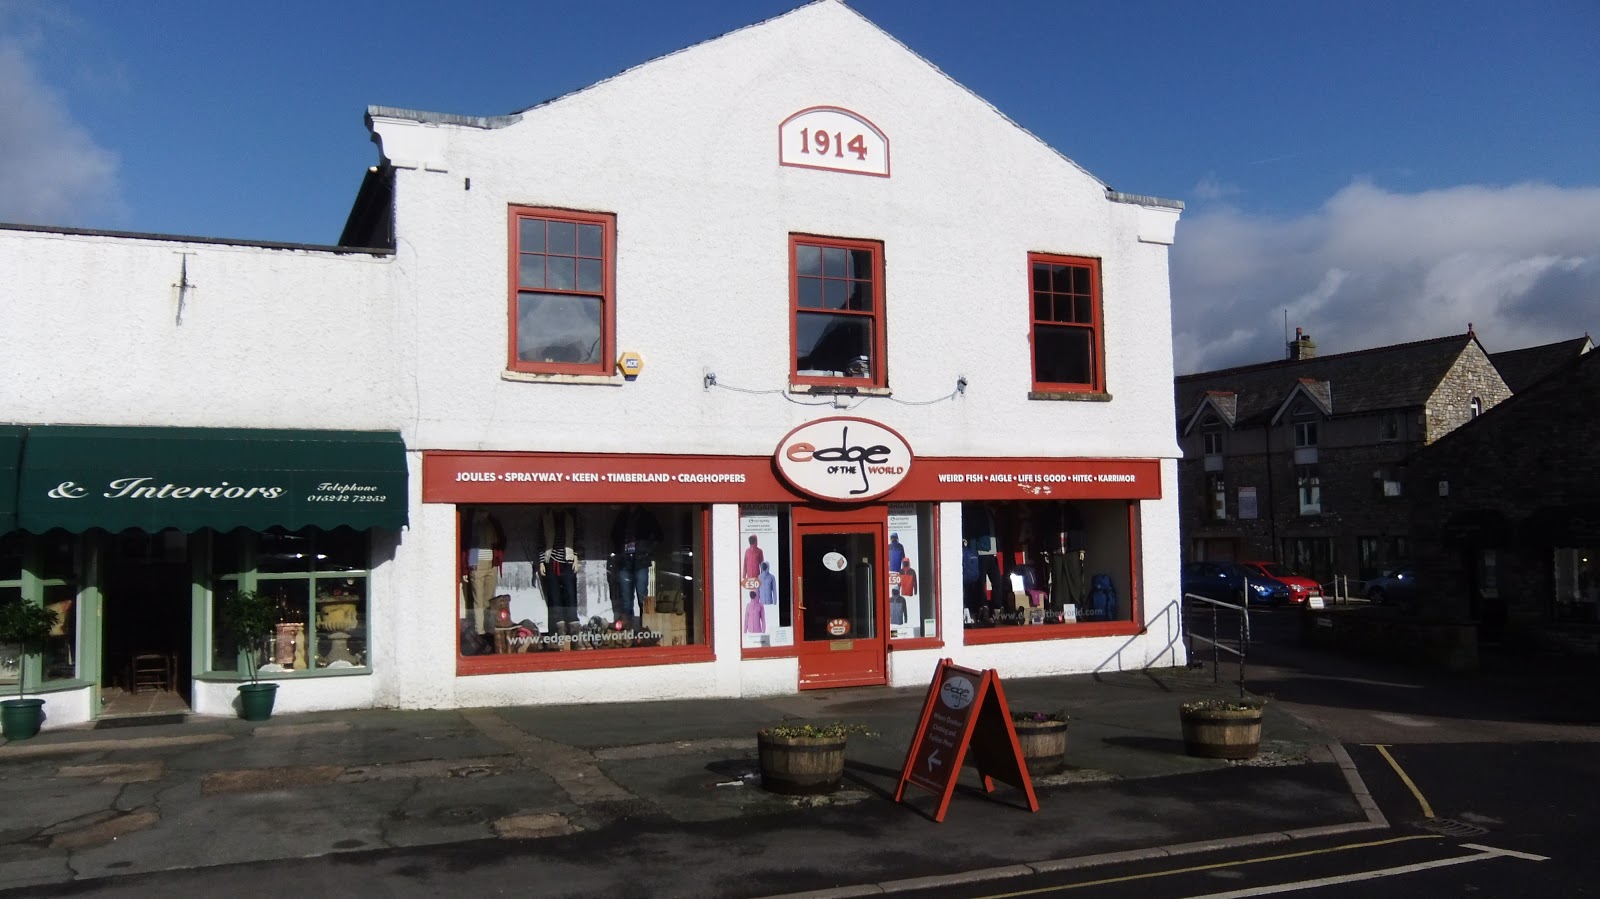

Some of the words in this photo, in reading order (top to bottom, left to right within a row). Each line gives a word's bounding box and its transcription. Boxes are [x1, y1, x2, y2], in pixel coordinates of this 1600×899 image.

[800, 127, 868, 161] 1914
[786, 426, 891, 495] edge
[827, 465, 839, 475] OF
[840, 465, 857, 475] THE
[867, 466, 904, 475] WORLD
[455, 472, 496, 482] JOULES
[504, 472, 563, 482] SPRAYWAY
[572, 473, 599, 482] KEEN
[607, 473, 670, 482] TIMBERLAND
[678, 473, 746, 483] CRAGHOPPERS
[938, 474, 964, 482] WEIRD
[966, 474, 983, 482] FISH
[989, 474, 1012, 482] AIGLE
[1018, 474, 1033, 482] LIFE
[1034, 474, 1042, 482] IS
[1043, 474, 1067, 482] GOOD
[1072, 474, 1093, 482] HITEC
[1098, 474, 1135, 482] KARRIMOR
[47, 481, 89, 499] &
[103, 477, 288, 499] Interiors
[317, 482, 377, 493] Telephone
[507, 629, 663, 646] www.edgeoftheworld.com
